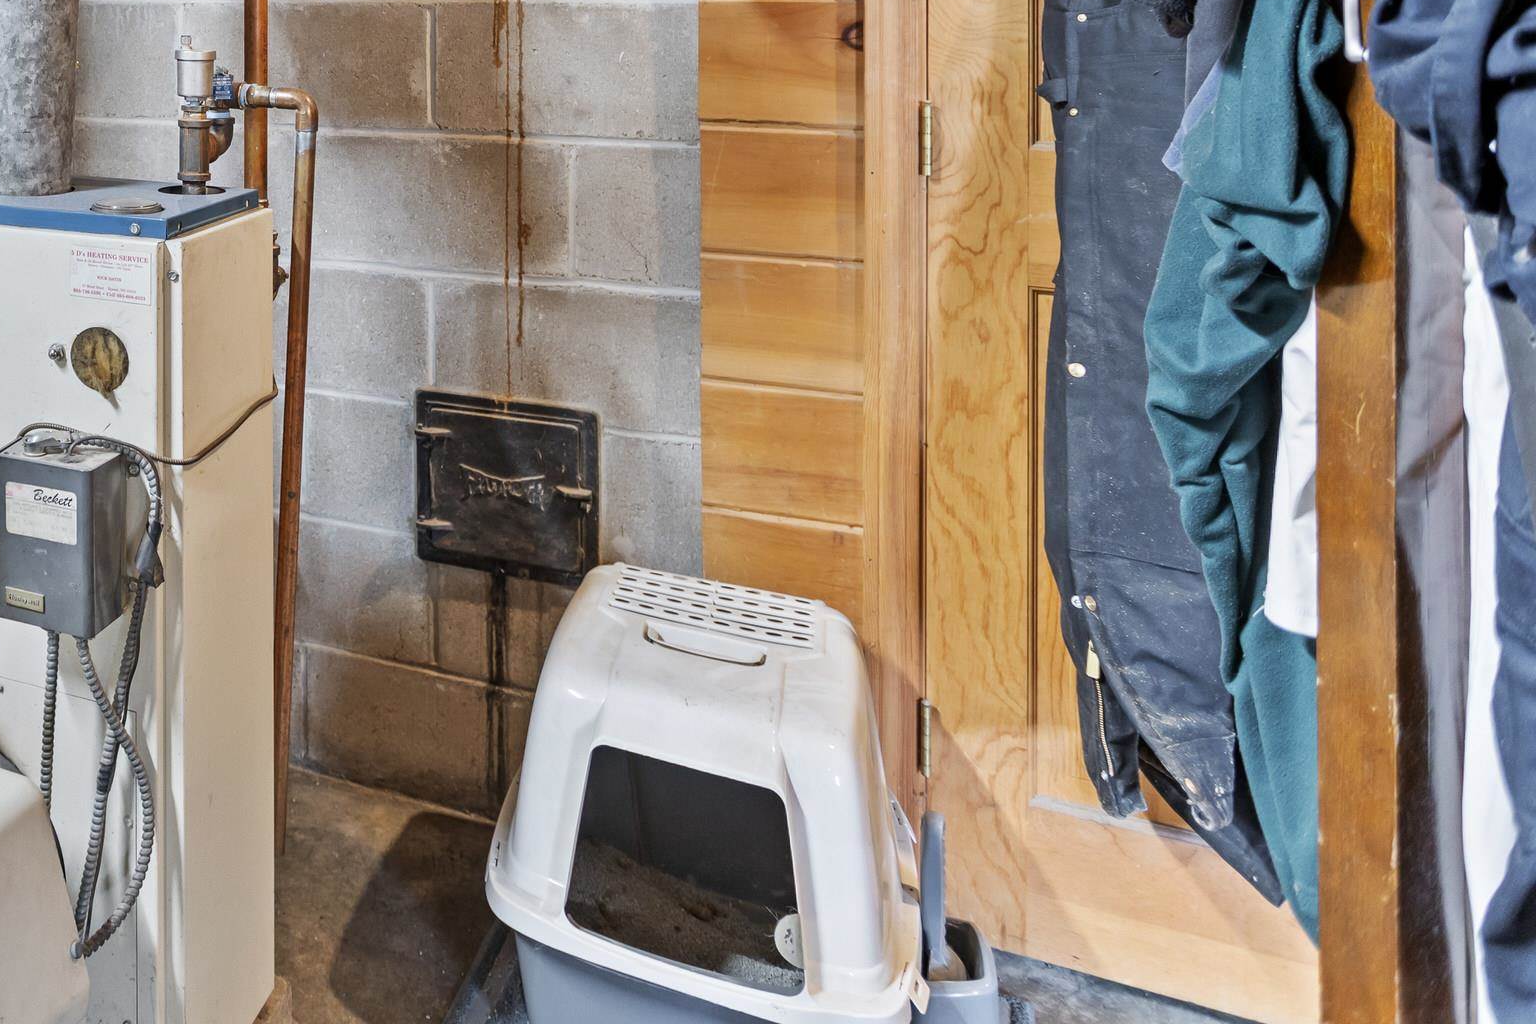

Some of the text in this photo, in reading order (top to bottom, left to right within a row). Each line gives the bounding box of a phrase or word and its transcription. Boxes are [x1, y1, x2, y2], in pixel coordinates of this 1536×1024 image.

[86, 251, 118, 260] HEATING
[118, 255, 149, 264] SERVICE
[32, 488, 73, 508] Beckett
